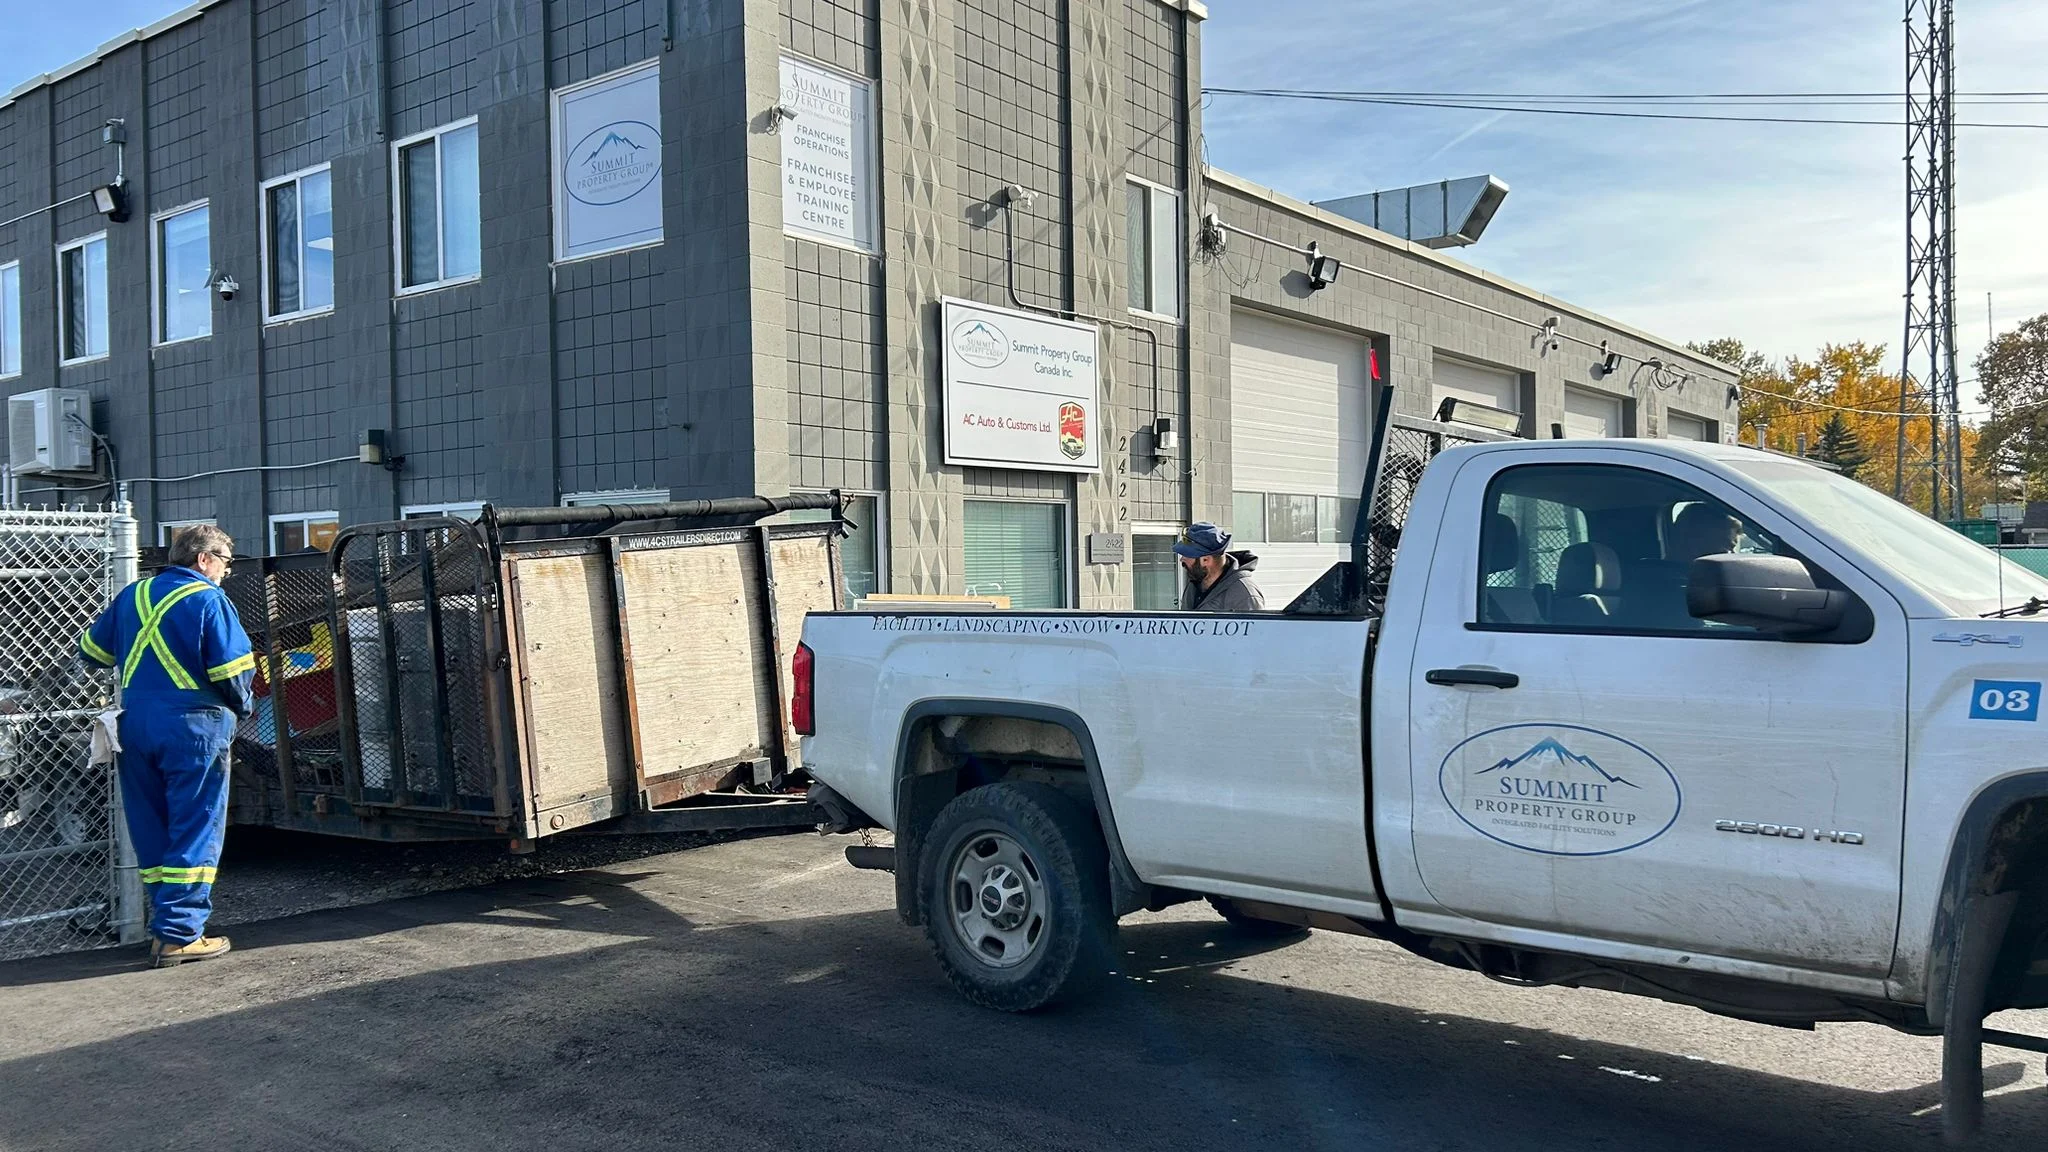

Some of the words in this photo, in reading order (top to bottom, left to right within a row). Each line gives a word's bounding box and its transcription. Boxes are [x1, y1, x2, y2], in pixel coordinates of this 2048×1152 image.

[792, 73, 846, 104] SUMMIT
[797, 124, 846, 147] FRANCHISE
[793, 136, 849, 160] OPERATIONS
[590, 152, 636, 174] SUMMIT
[787, 158, 856, 186] FRANCHISEE
[577, 173, 617, 189] PROPERTY
[787, 174, 795, 185] &
[799, 177, 857, 201] EMPLOYEE
[796, 192, 849, 215] TRAINING
[802, 210, 845, 229] CENTRE
[966, 337, 995, 349] SUMMIT
[1012, 340, 1039, 356] Summit
[1041, 344, 1071, 363] Property
[1072, 350, 1093, 367] Group
[1034, 362, 1060, 377] Canada
[1062, 366, 1073, 378] Inc.
[962, 413, 975, 425] AC
[977, 415, 996, 428] Auto
[998, 416, 1004, 429] &
[1006, 417, 1037, 432] Customs
[1039, 421, 1052, 433] Ltd.
[1212, 621, 1255, 636] LOT
[1979, 689, 2030, 712] 03
[1500, 776, 1608, 803] SUMMIT
[1474, 799, 1566, 819] PROPERTY
[1571, 808, 1637, 826] GROUP
[1492, 818, 1538, 829] INTEGRATED
[1539, 823, 1572, 833] FACILITY
[1573, 827, 1616, 837] SOLUTIONS
[1715, 819, 1805, 839] 2500
[1813, 828, 1864, 845] HD
